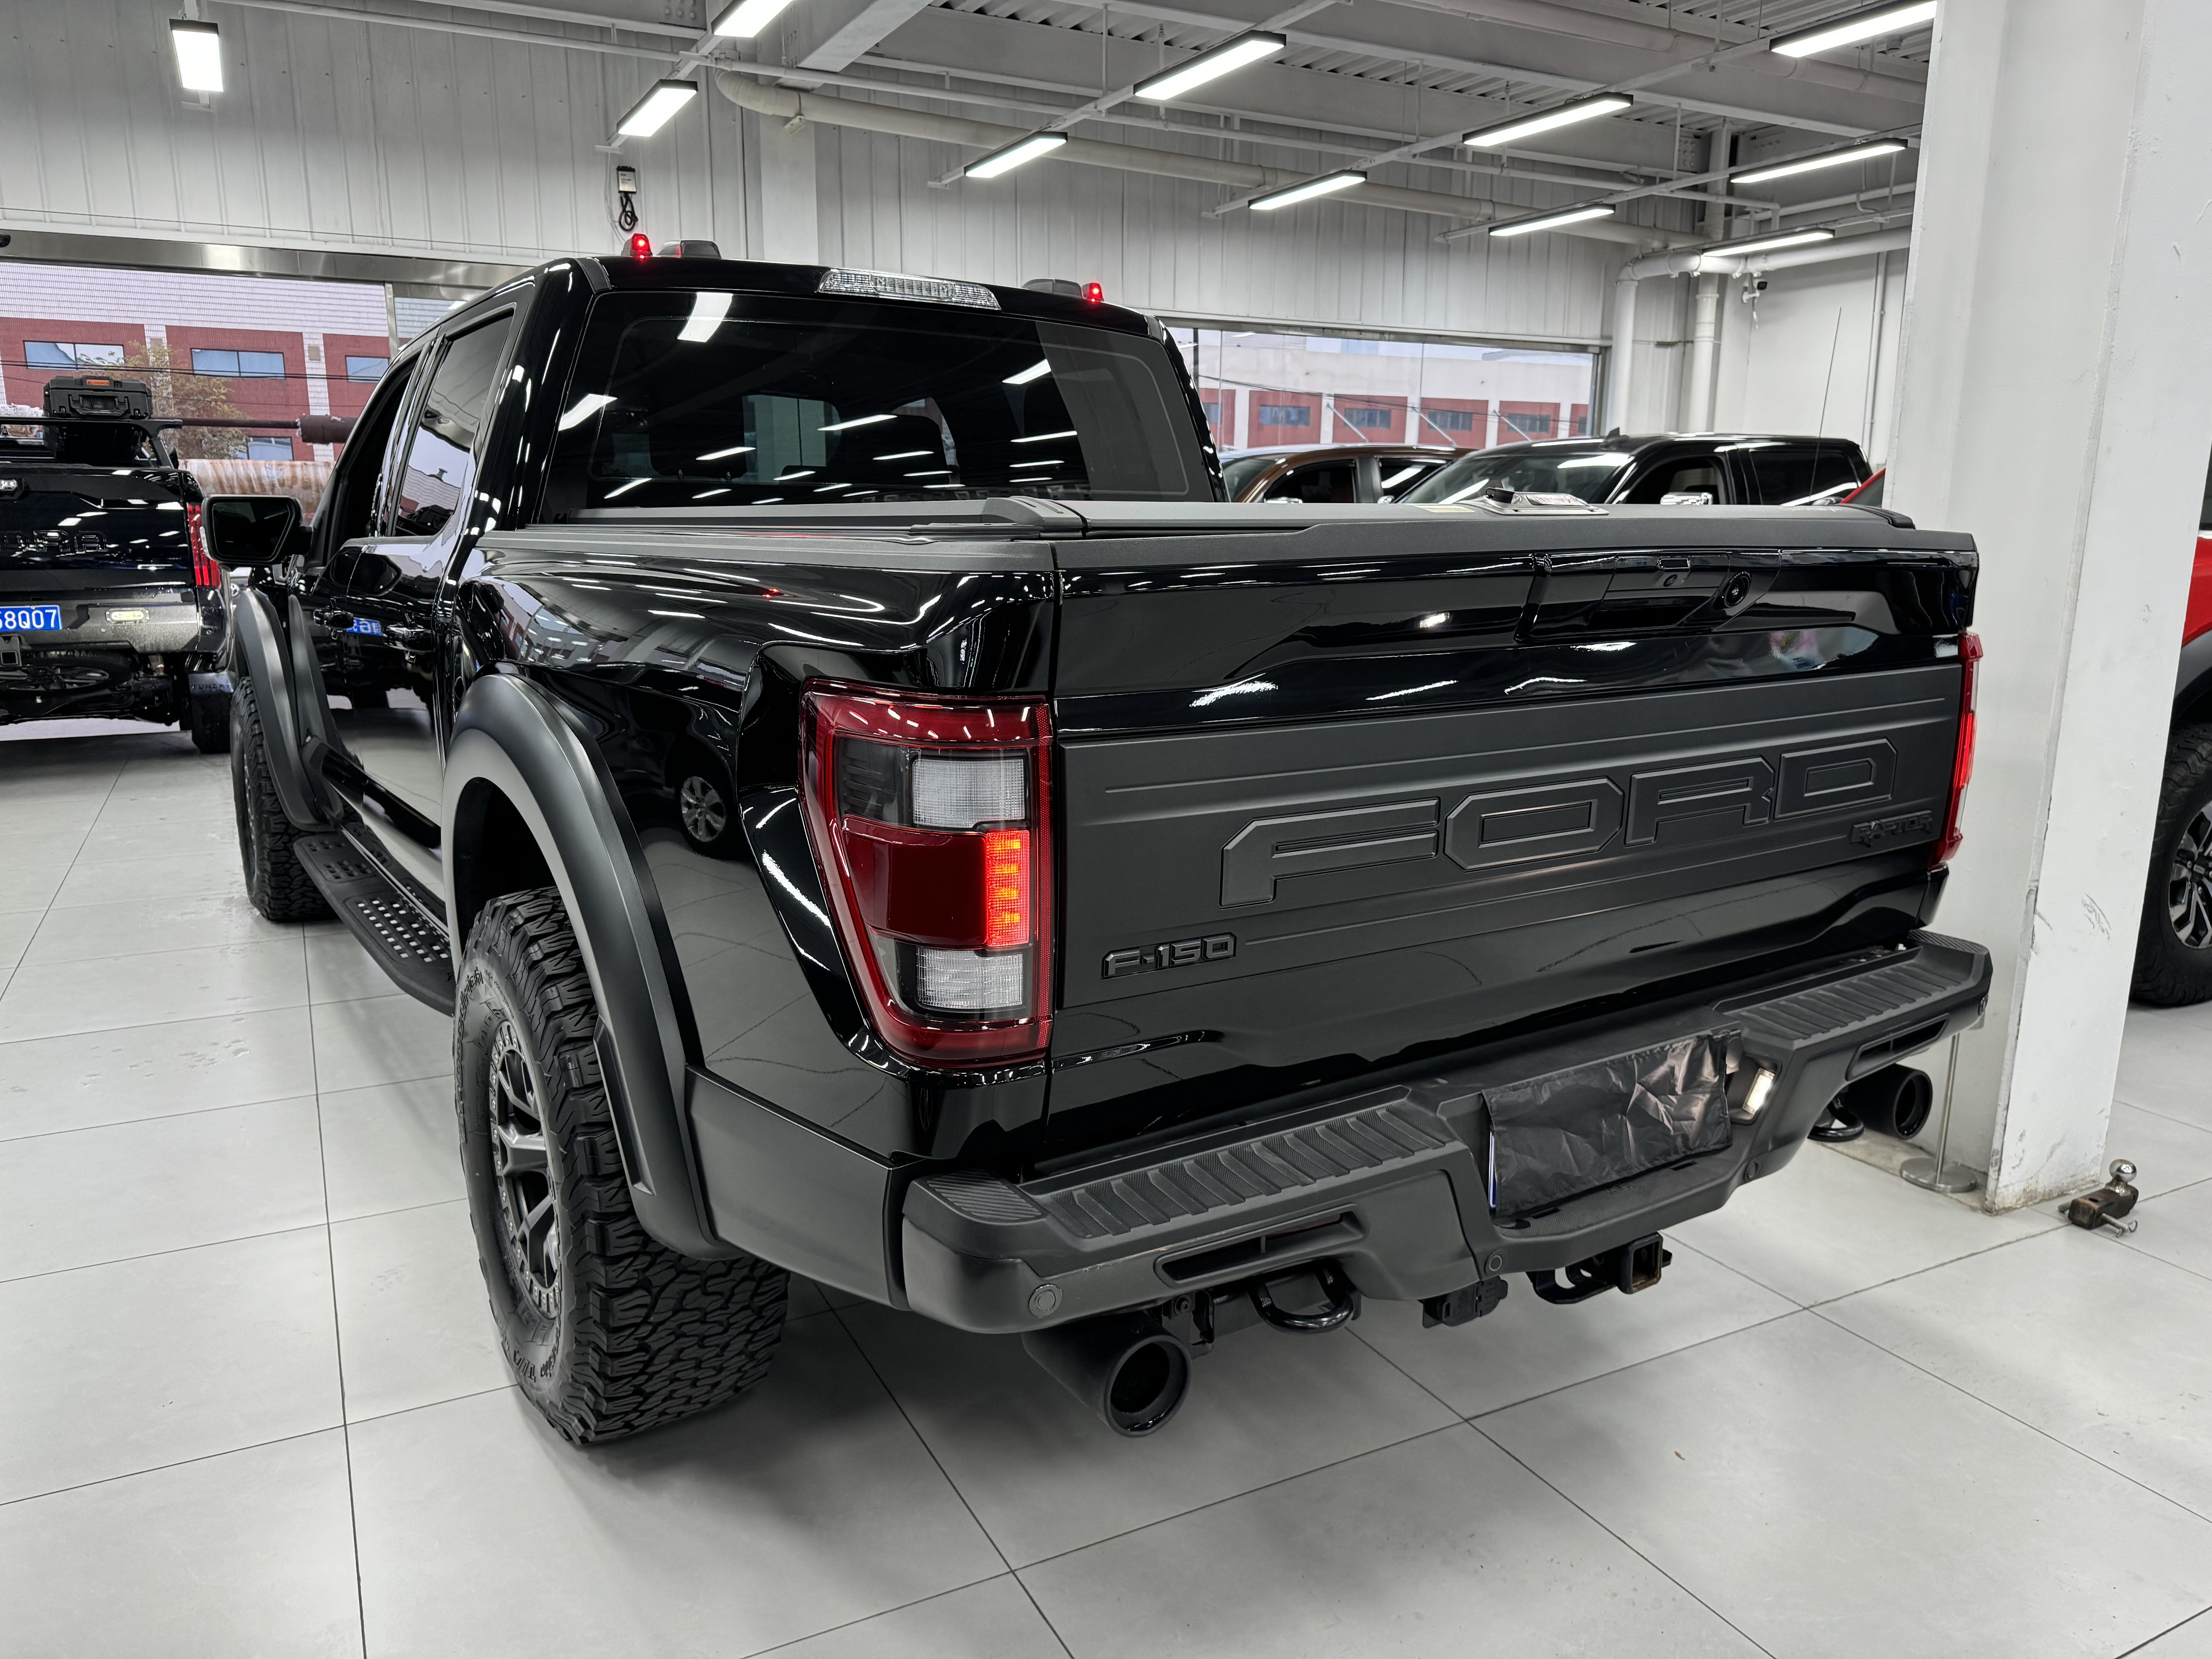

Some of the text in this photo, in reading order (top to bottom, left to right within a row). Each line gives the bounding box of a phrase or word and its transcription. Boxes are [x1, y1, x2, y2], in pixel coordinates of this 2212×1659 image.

[0, 610, 57, 629] 8Q07
[1219, 737, 1897, 909] FORD
[1850, 810, 1932, 848] RAPTOR
[1103, 932, 1237, 978] F-150
